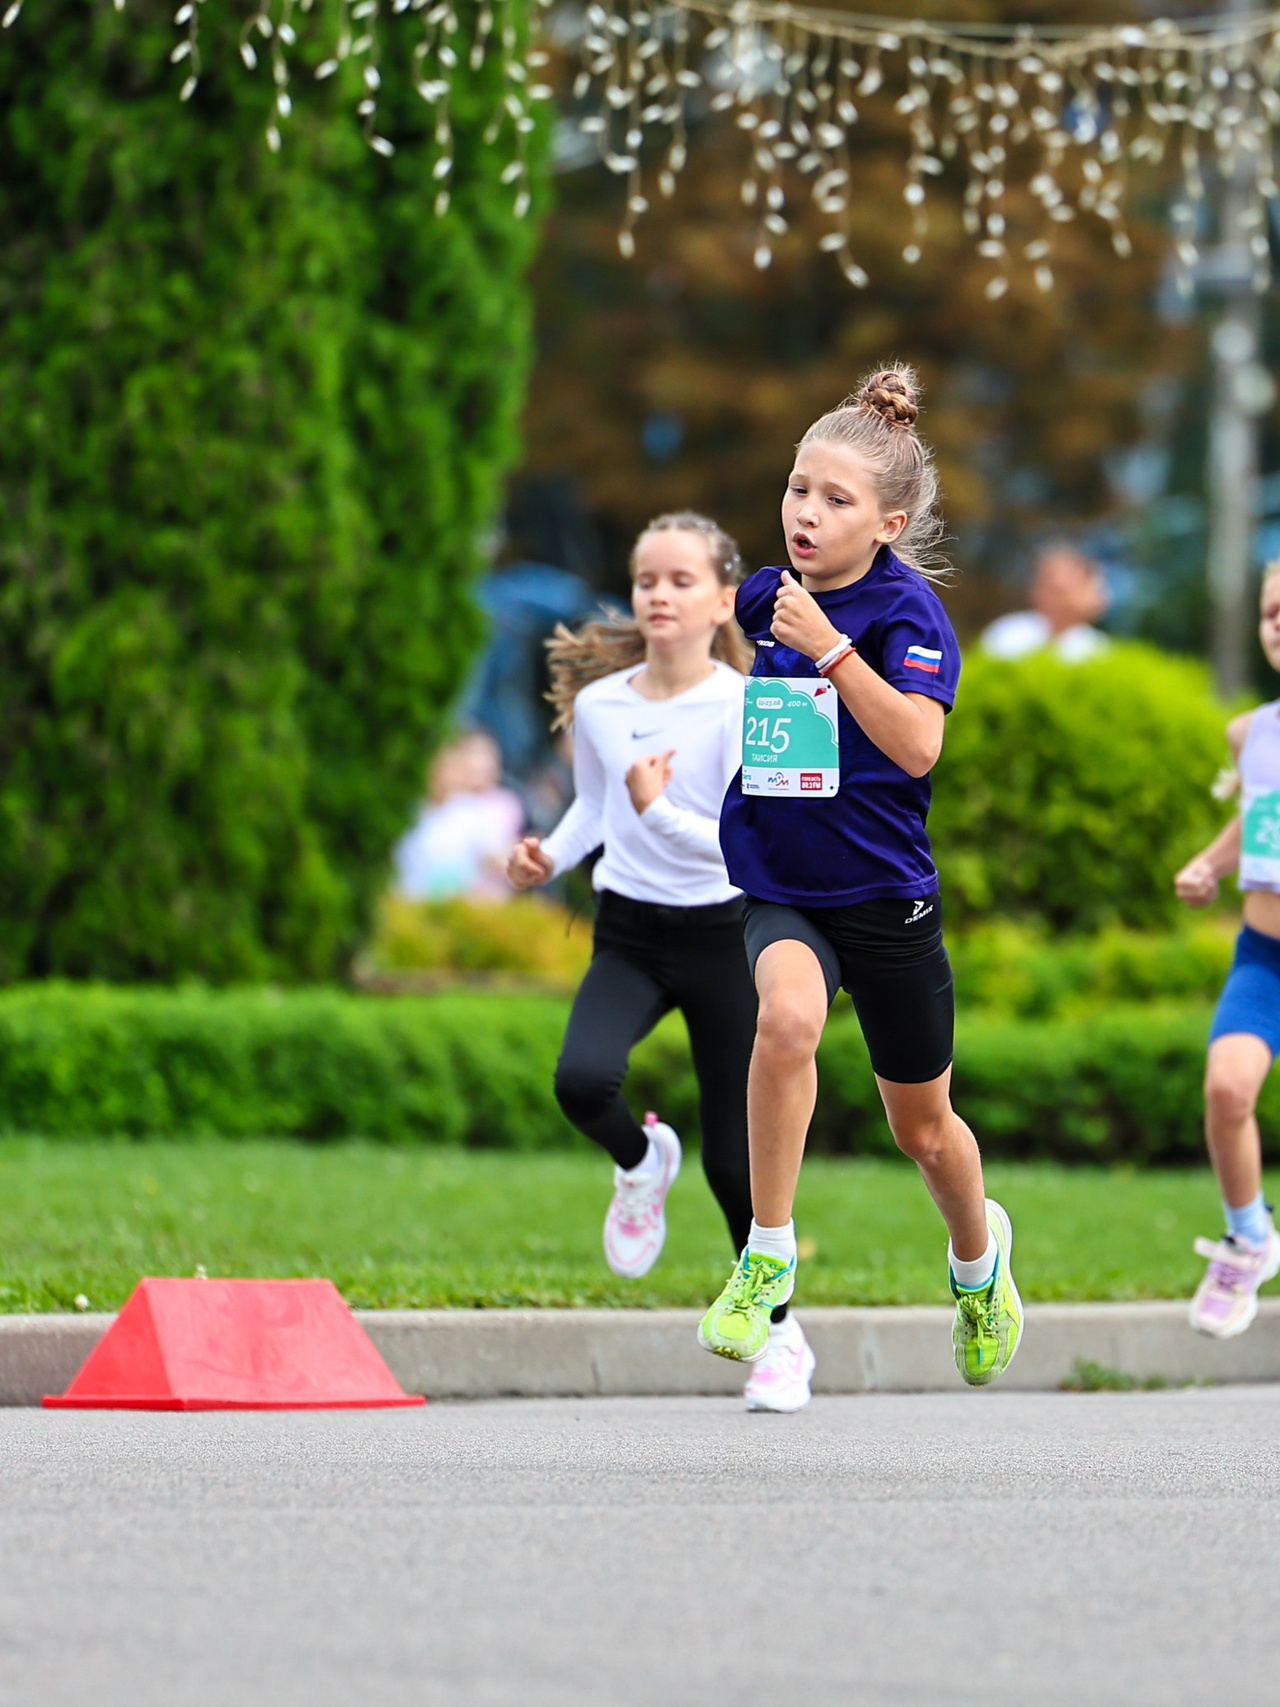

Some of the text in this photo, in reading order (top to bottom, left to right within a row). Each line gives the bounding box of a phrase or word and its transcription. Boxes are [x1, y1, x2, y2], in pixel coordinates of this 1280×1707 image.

[787, 700, 801, 708] 400
[745, 716, 792, 754] 215
[751, 753, 778, 763] ТАИСИЯ
[904, 904, 934, 924] DEMIX
